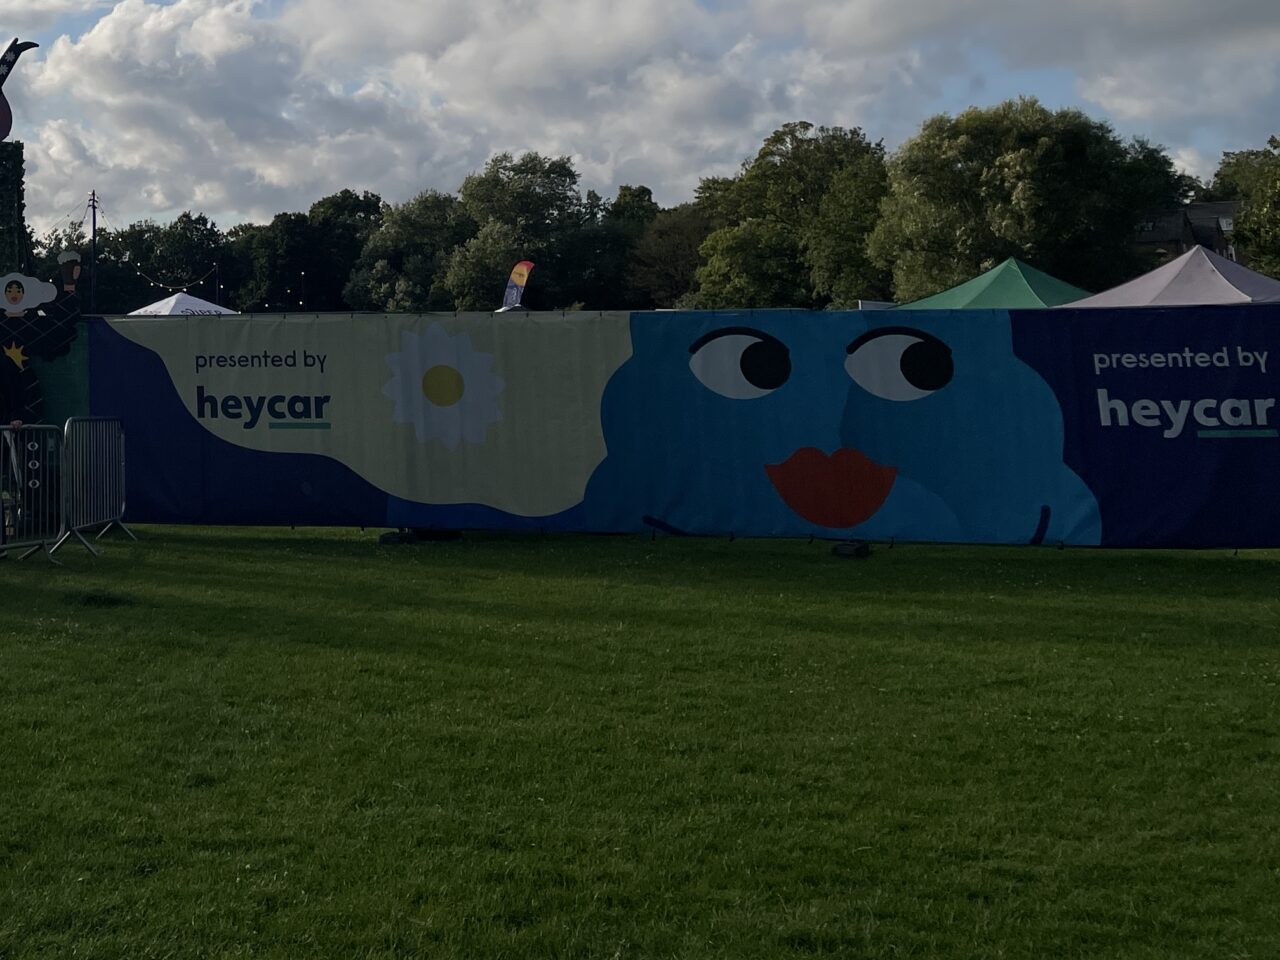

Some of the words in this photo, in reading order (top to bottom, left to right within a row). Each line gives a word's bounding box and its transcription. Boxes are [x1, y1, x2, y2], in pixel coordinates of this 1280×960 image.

[195, 350, 297, 374] presented
[303, 350, 327, 374] by
[1093, 346, 1230, 375] presented
[1237, 345, 1269, 374] by
[196, 386, 331, 429] heycar
[1096, 388, 1277, 439] heycar
